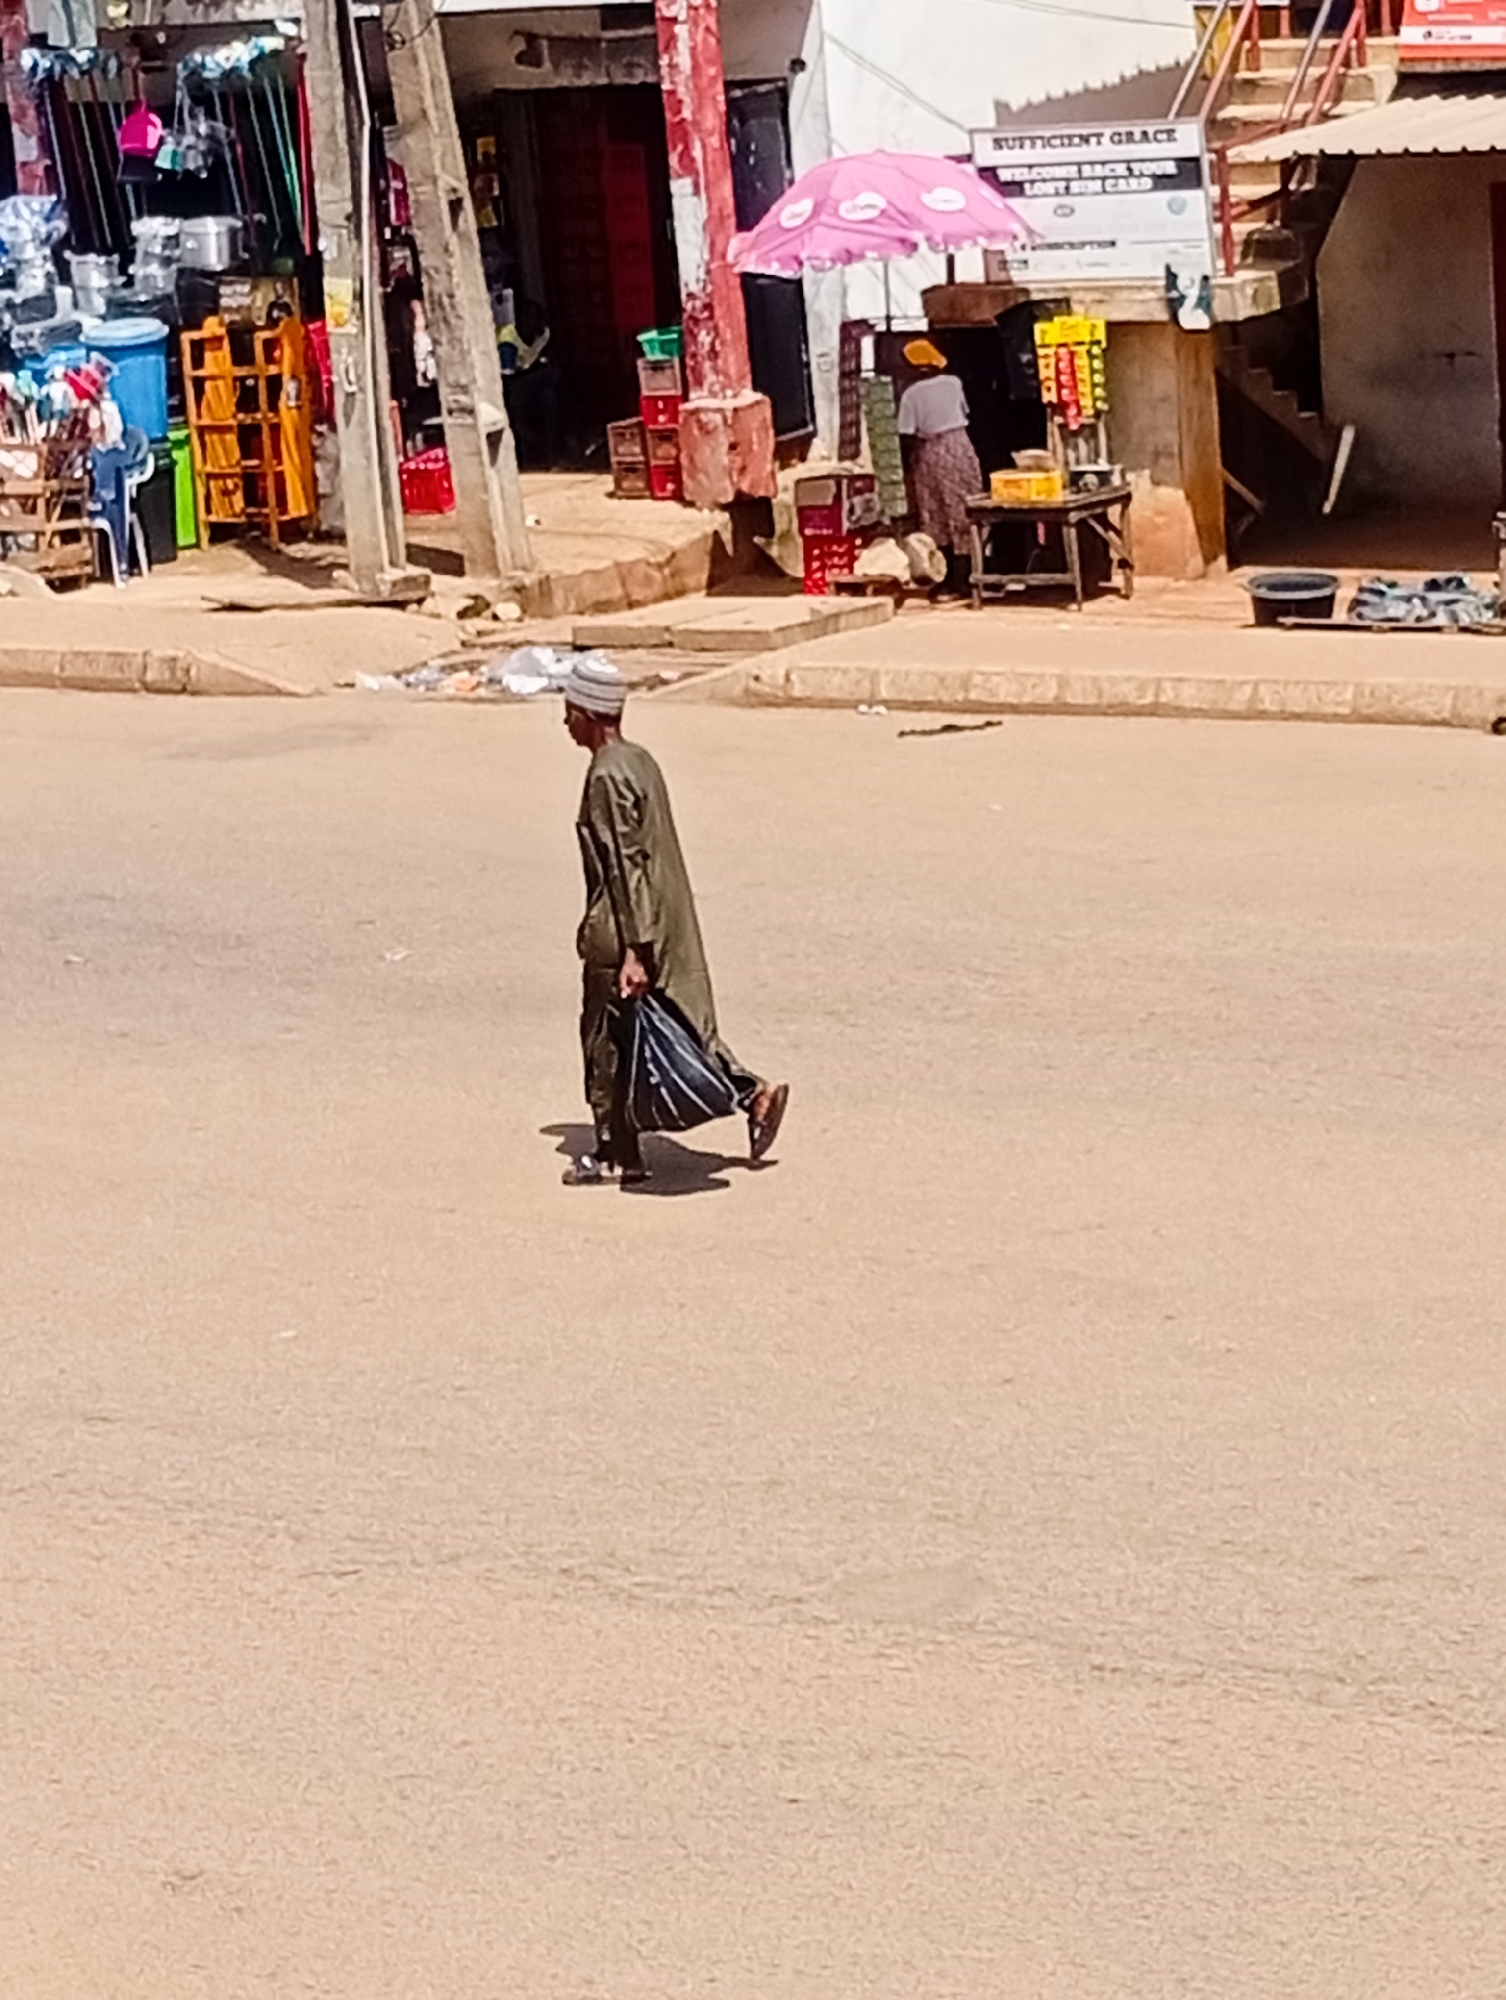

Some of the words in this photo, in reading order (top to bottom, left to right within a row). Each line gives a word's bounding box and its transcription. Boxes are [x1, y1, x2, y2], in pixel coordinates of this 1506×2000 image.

[993, 133, 1104, 151] SUFFICIENT
[1109, 128, 1177, 145] GRACE
[1129, 160, 1178, 175] YOUR
[1103, 177, 1153, 192] CARD
